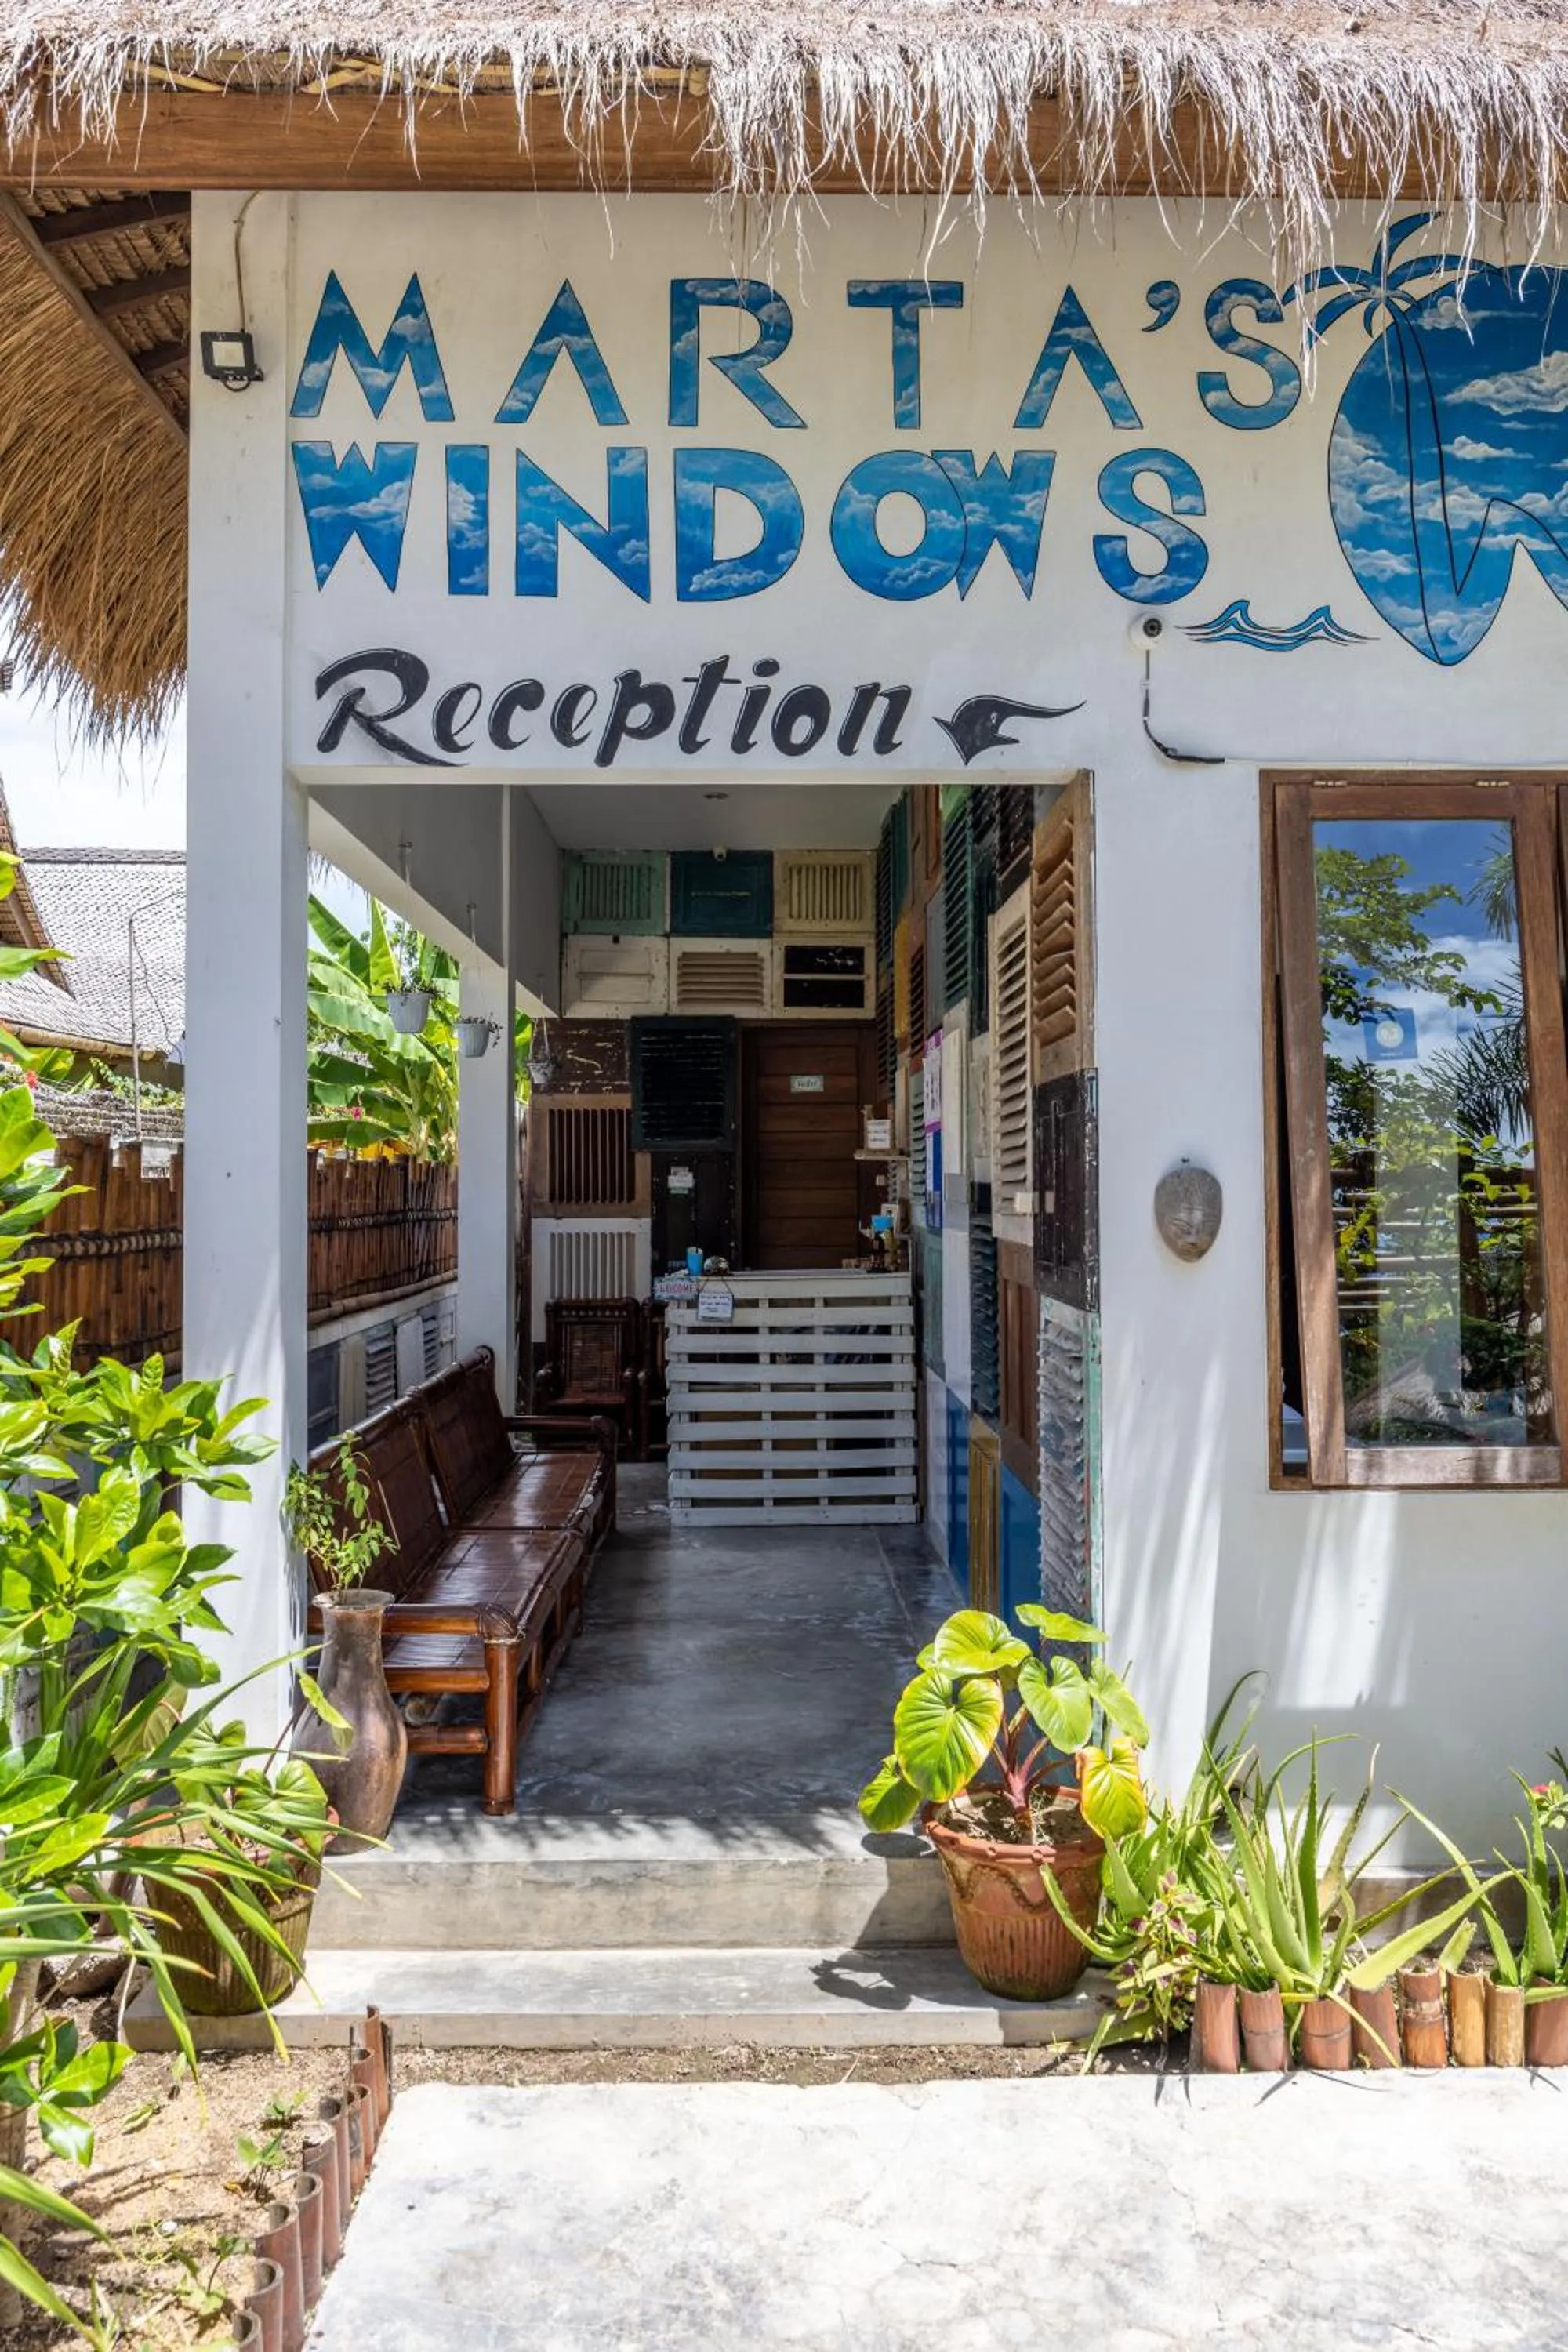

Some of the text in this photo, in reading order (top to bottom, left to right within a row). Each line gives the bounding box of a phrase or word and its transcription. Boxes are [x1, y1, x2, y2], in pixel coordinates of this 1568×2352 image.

[290, 269, 1302, 430] MARTA'S
[290, 441, 1209, 605] WINDOWS
[315, 648, 913, 768] Reception
